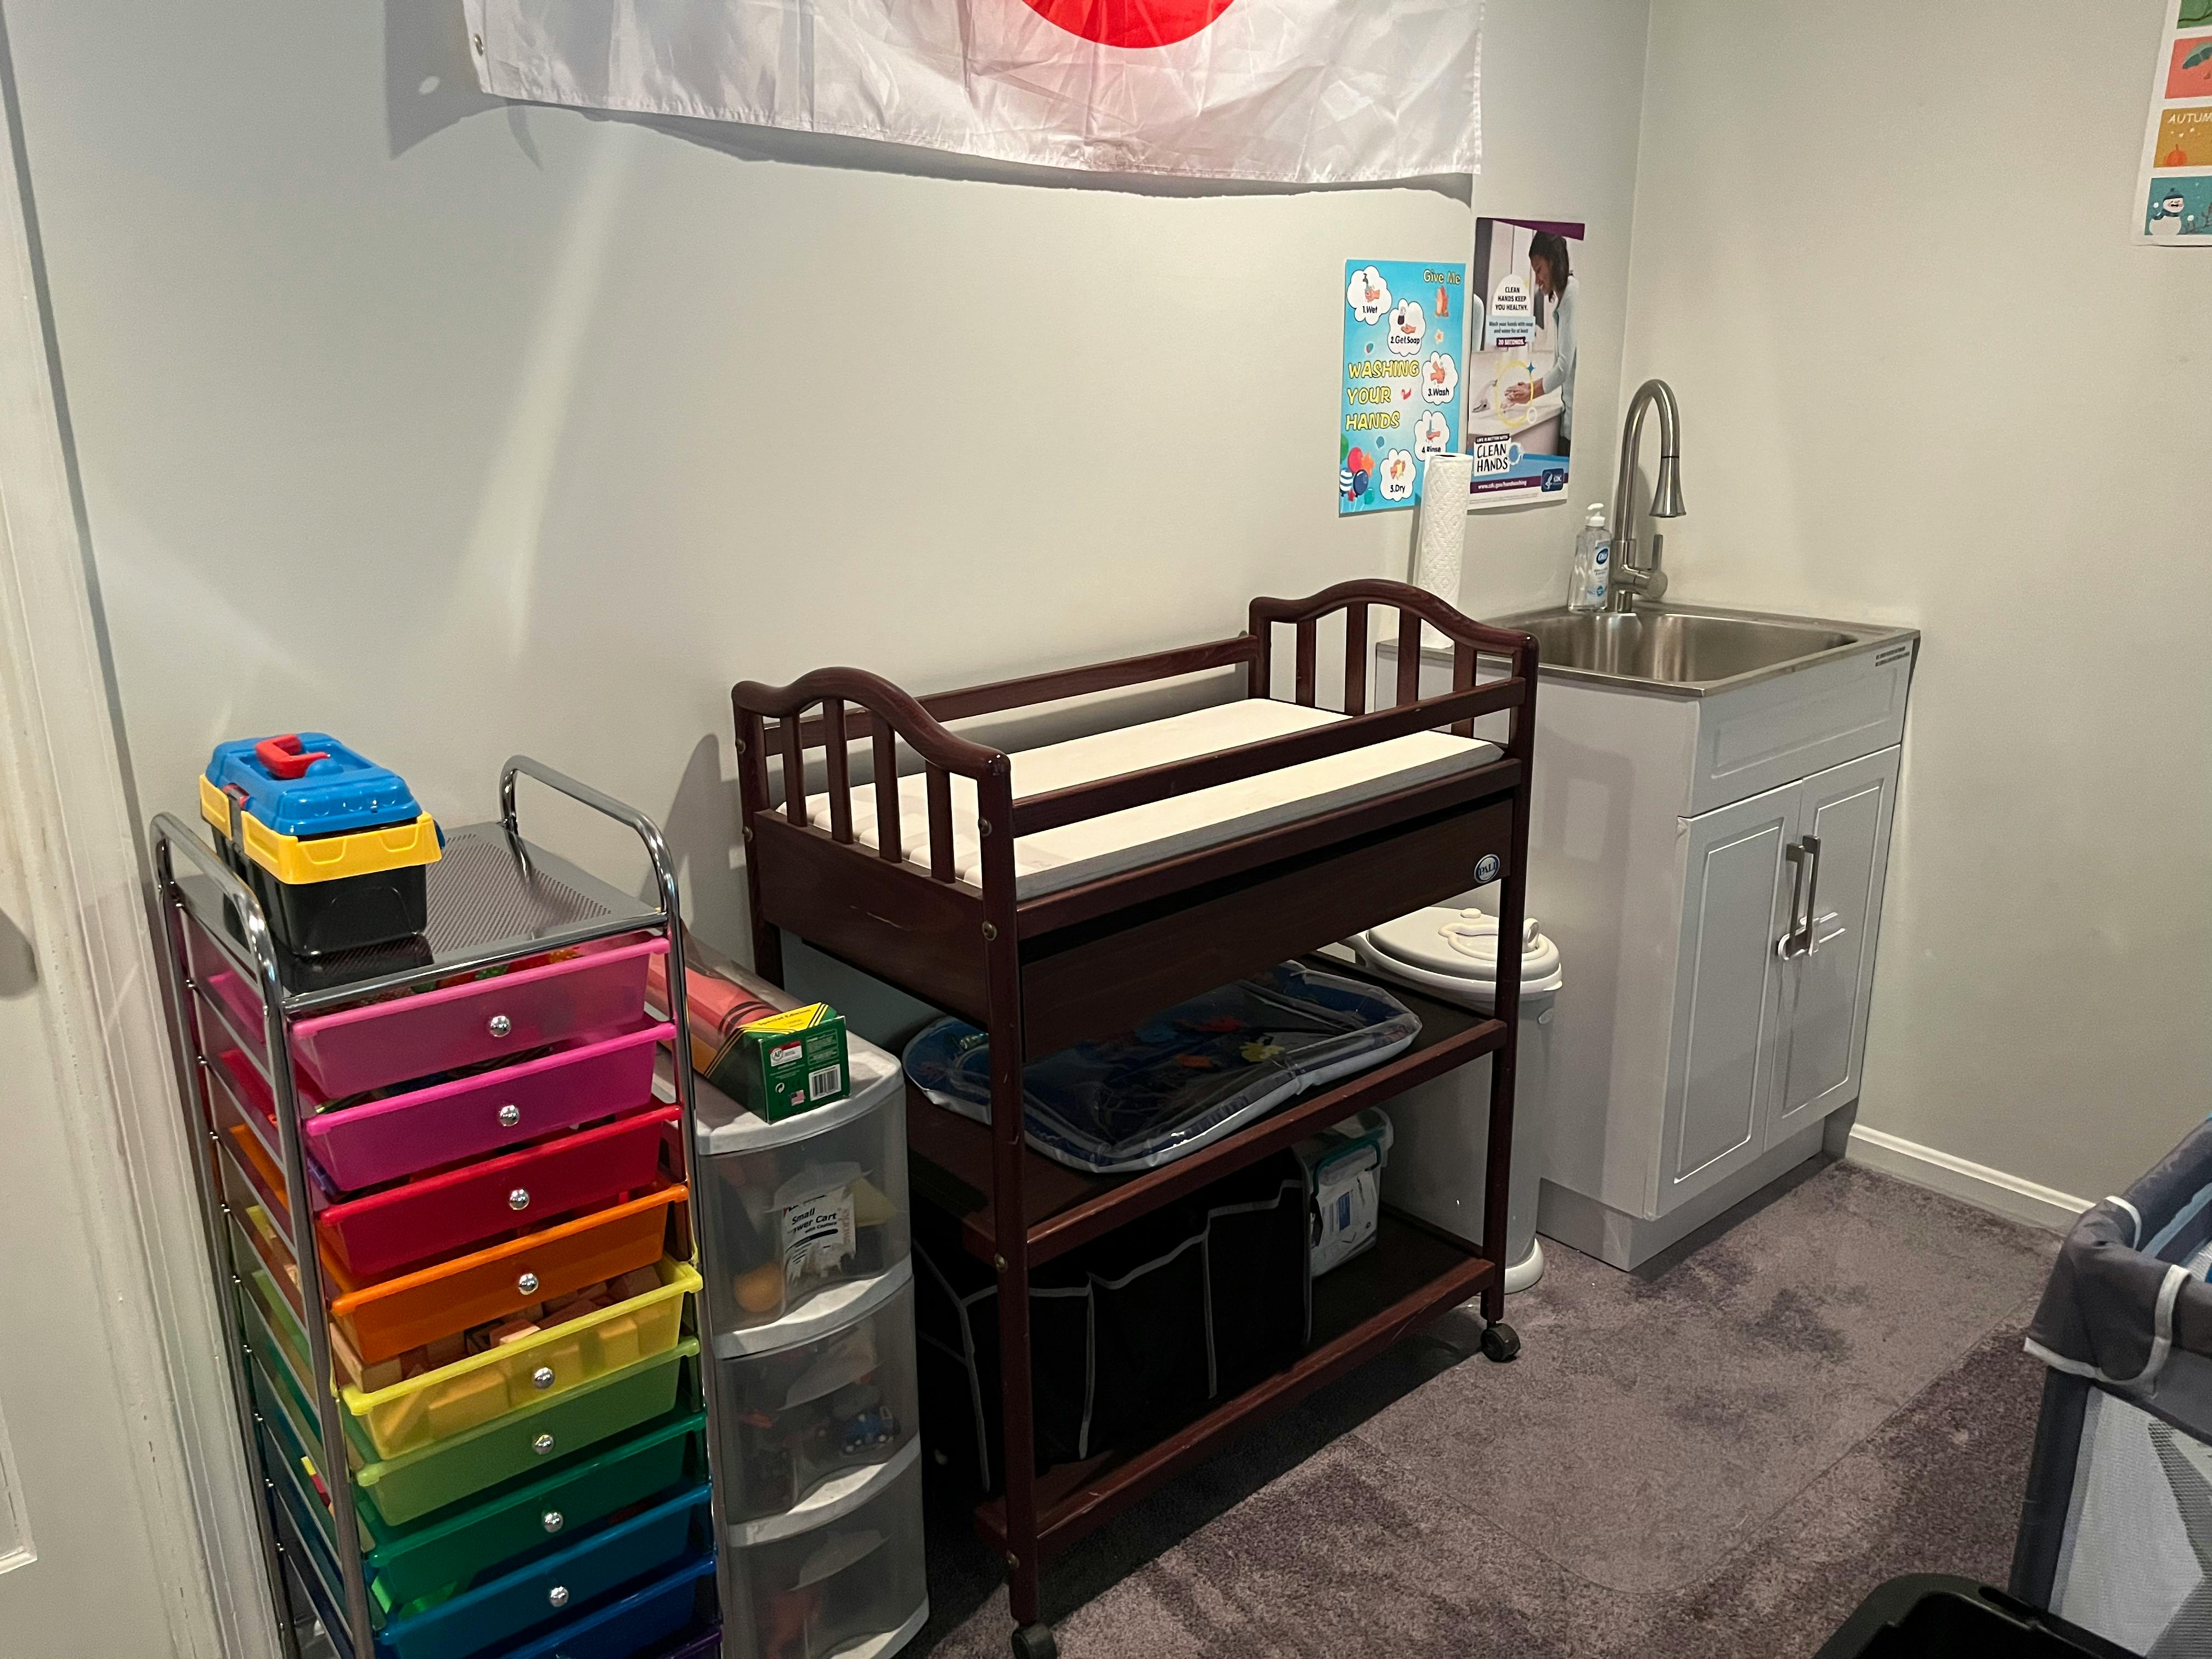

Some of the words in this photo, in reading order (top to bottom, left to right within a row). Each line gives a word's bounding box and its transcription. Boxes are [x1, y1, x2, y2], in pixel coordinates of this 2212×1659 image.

[1423, 269, 1444, 283] Give
[1447, 271, 1461, 285] Me
[1362, 306, 1378, 314] 1.Wet
[1348, 360, 1420, 379] WASHING
[1347, 386, 1391, 405] YOUR
[1427, 387, 1449, 397] 3.Wash
[1345, 410, 1400, 431] HANDS
[1477, 443, 1506, 459] CLEAN
[1477, 457, 1508, 472] HANDS
[1390, 484, 1406, 493] 5.Dry
[1478, 862, 1496, 876] PALI
[787, 1220, 813, 1234] awer
[816, 1213, 837, 1223] Cart
[792, 1207, 815, 1225] Small
